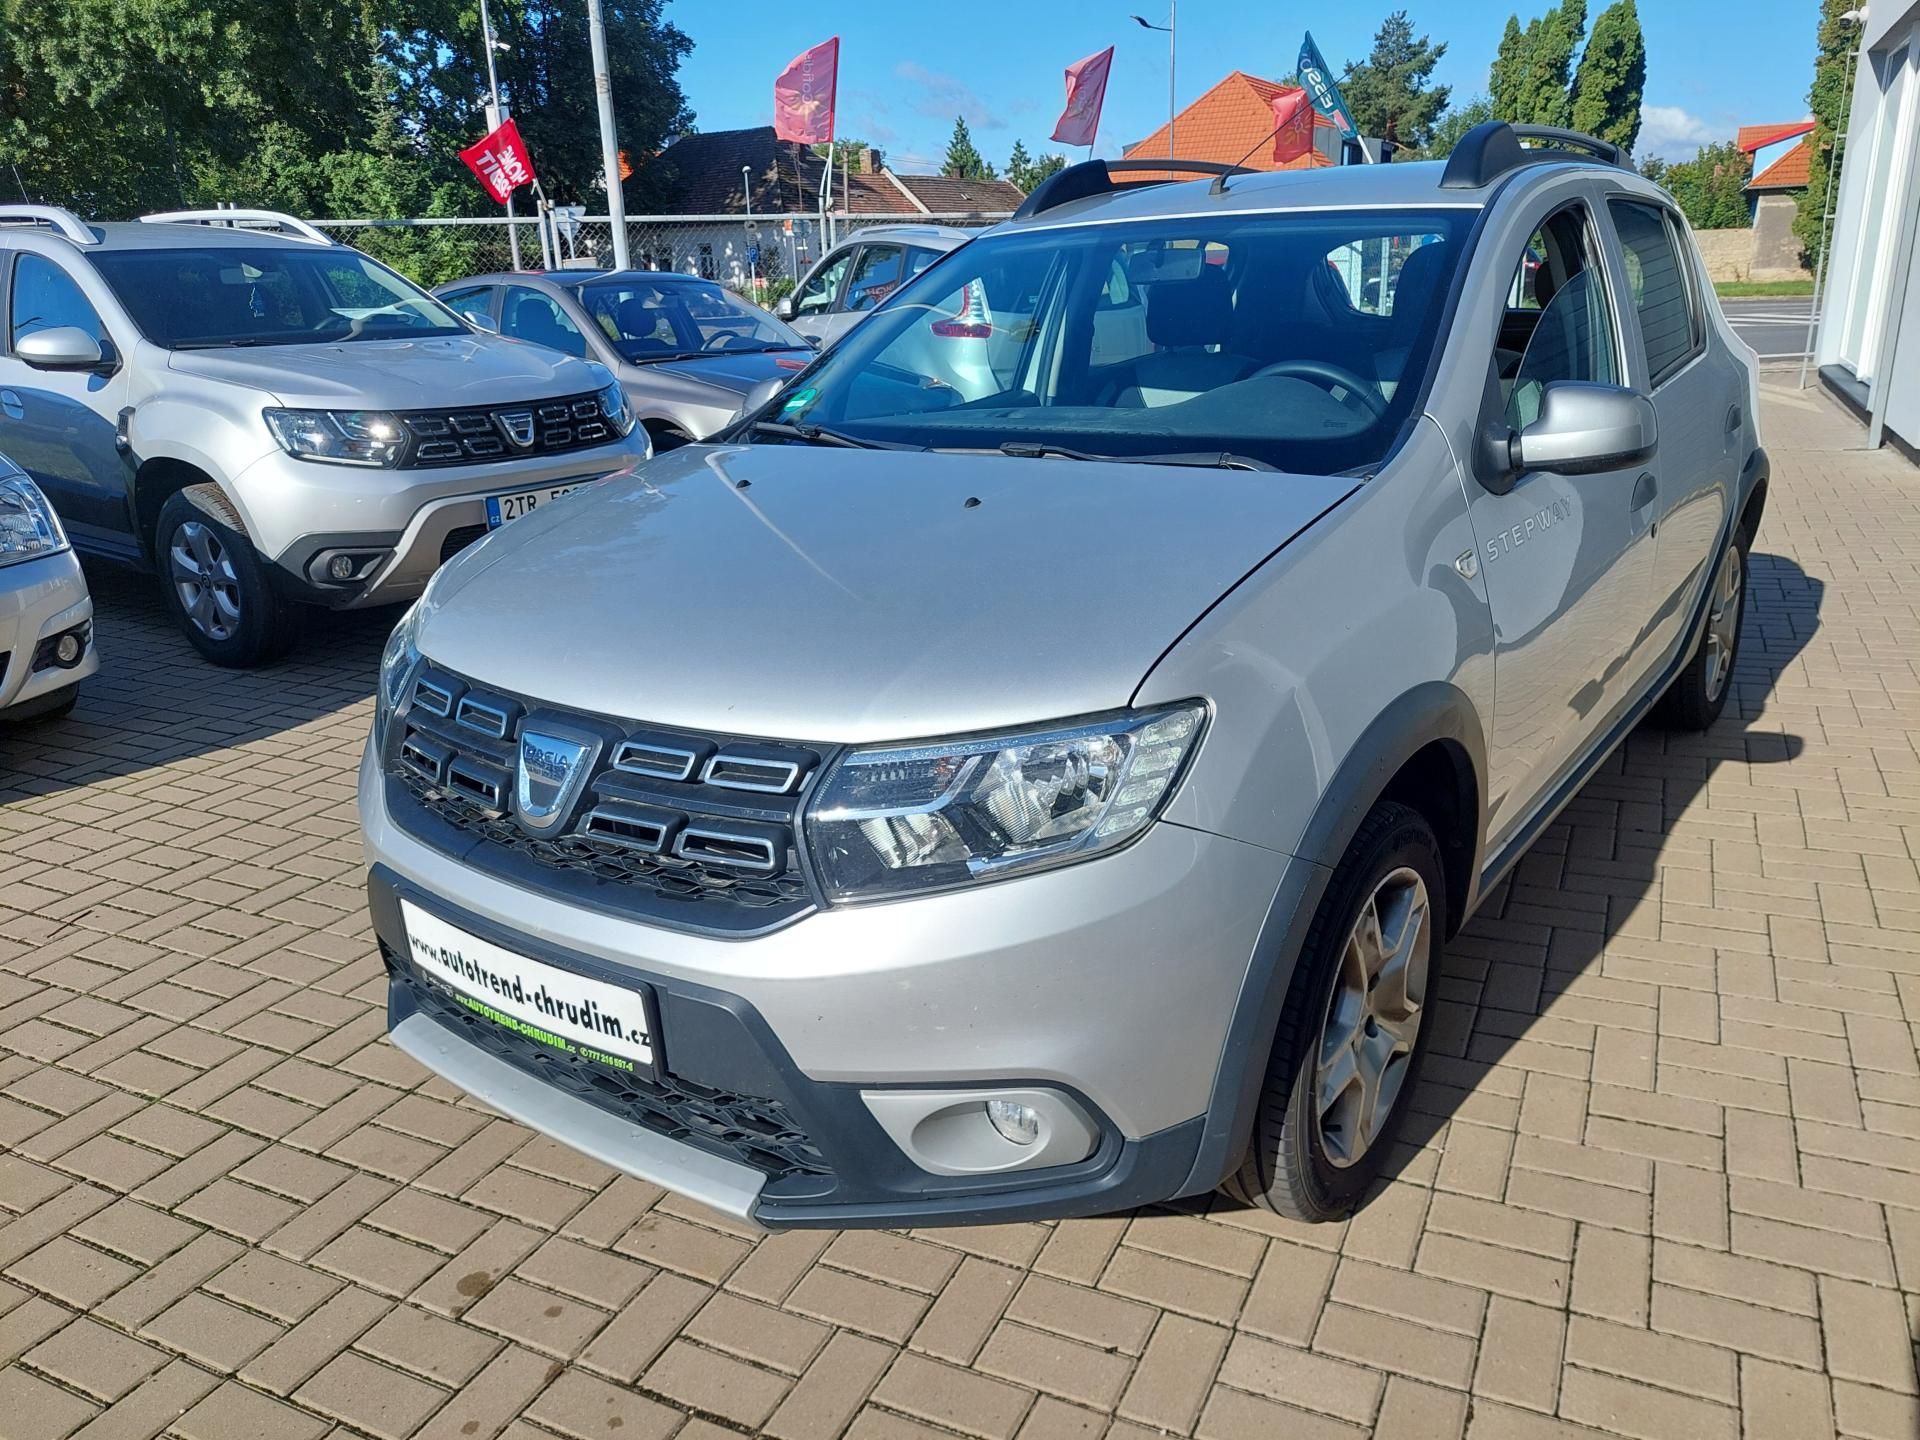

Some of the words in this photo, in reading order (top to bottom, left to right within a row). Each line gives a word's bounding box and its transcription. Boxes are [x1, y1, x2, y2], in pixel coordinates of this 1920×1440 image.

[504, 495, 537, 520] 2TR
[1486, 495, 1571, 562] STEPWAY
[525, 743, 568, 767] DACIA
[409, 933, 652, 1047] www.autotrend-chrudim.cz
